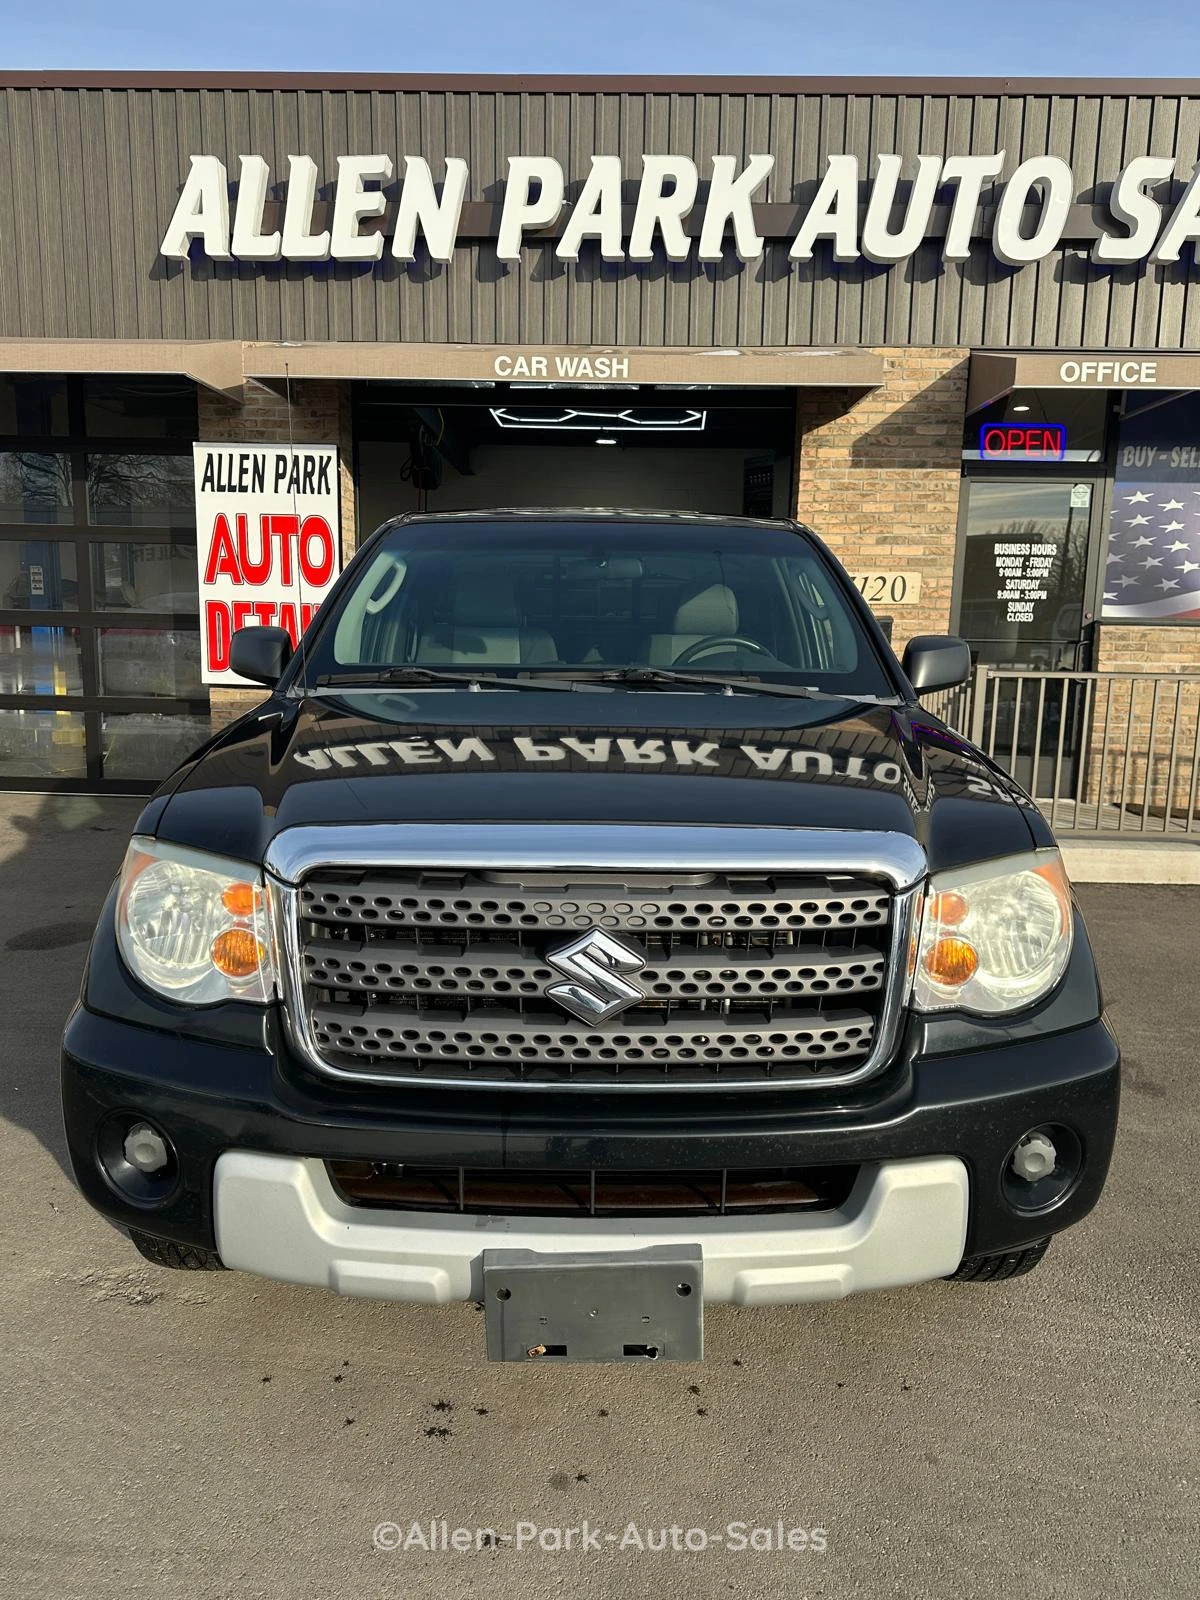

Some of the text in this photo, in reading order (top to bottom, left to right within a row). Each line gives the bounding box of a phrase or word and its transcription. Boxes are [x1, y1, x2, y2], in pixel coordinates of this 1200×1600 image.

[160, 154, 469, 264] ALLEN
[496, 154, 774, 264] PARK
[789, 150, 1074, 266] AUTO
[494, 355, 630, 379] CAR WASH
[1059, 361, 1158, 384] OFFICE
[984, 429, 1061, 457] OPEN
[1123, 446, 1157, 468] BUY
[1170, 446, 1200, 468] SEL
[201, 453, 332, 495] ALLEN PARK
[203, 512, 335, 588] AUTO
[994, 543, 1057, 555] BUSINESS HOURS
[995, 557, 1024, 568] MONDAY
[1029, 557, 1053, 568] FRIDAY
[998, 568, 1022, 577] 9:00AM
[1026, 568, 1050, 577] 5:00PM
[850, 575, 907, 602] 120
[997, 590, 1021, 600] 9:00AM
[1005, 579, 1041, 590] SATURDAY
[1006, 612, 1034, 622] CLOSED
[1007, 601, 1035, 613] SUNDAY
